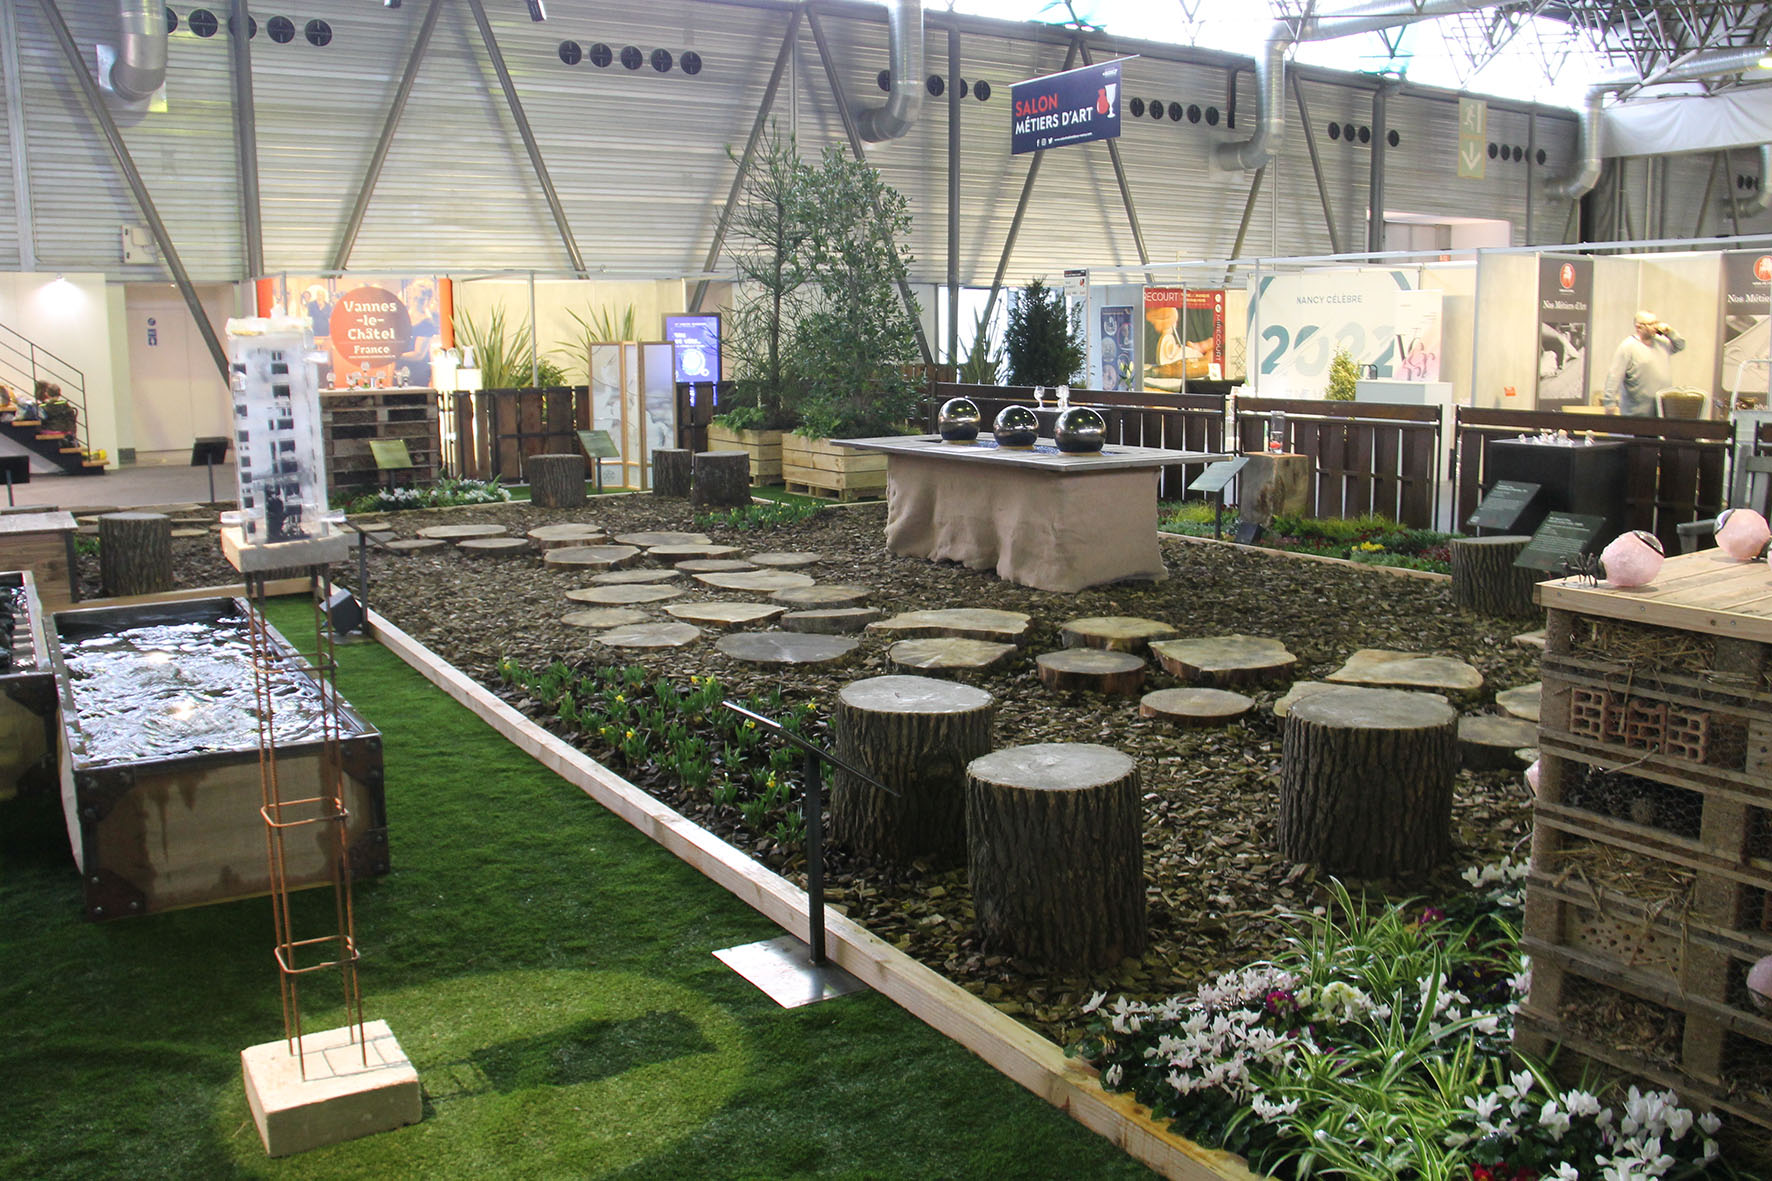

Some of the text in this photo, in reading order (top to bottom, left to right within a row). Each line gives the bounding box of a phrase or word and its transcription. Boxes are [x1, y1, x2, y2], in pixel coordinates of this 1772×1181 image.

[1015, 93, 1059, 117] SALON
[1015, 107, 1094, 135] MÉTIERS D'ART
[1296, 292, 1363, 304] NANCY CÉLÈBRE
[1727, 293, 1745, 304] Nos
[343, 301, 397, 313] Vannes
[1542, 299, 1554, 310] Nos
[1554, 299, 1575, 310] Métiers
[356, 314, 384, 326] -le-
[347, 328, 395, 340] Châtel
[353, 345, 390, 354] France
